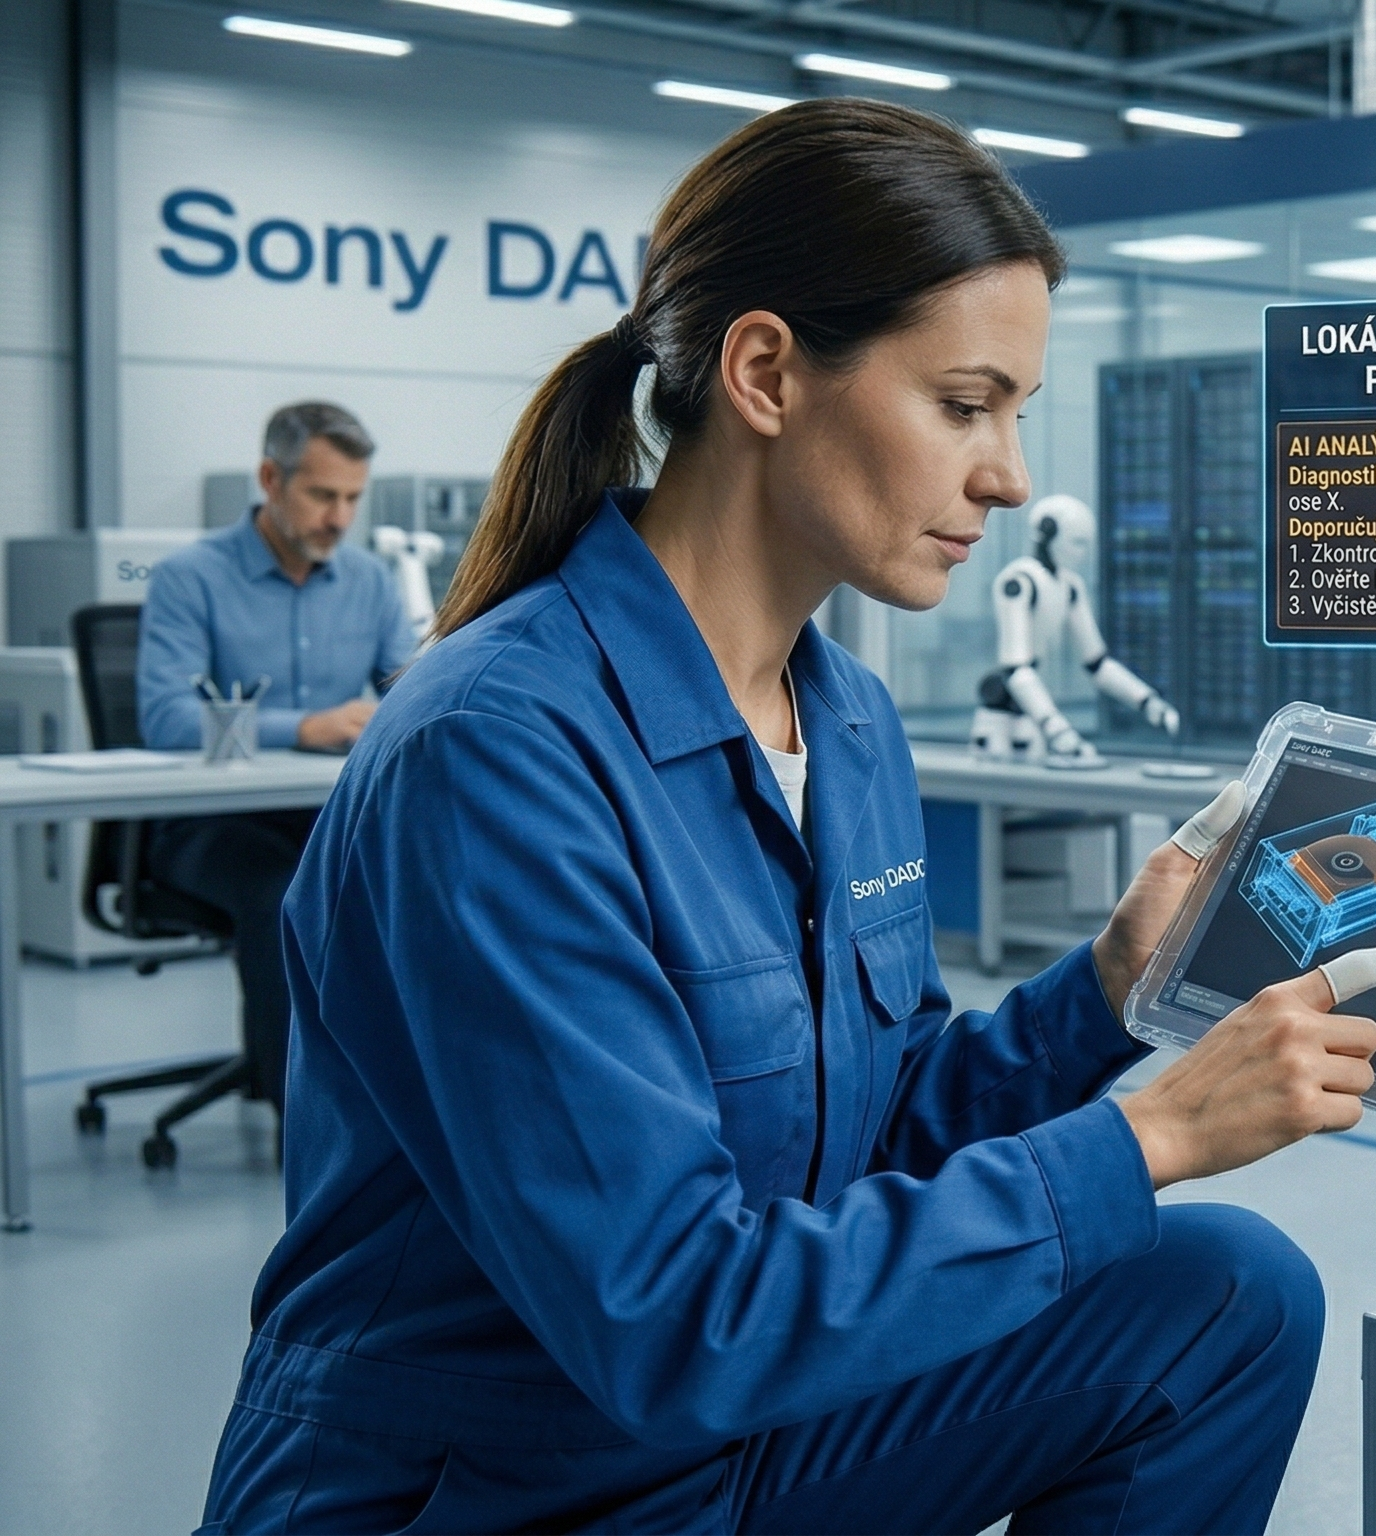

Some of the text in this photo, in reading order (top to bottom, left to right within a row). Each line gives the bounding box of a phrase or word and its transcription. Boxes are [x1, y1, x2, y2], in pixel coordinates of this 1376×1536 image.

[157, 187, 651, 312] Sony DA
[1289, 436, 1310, 457] AI
[1288, 491, 1345, 511] ose X.
[1289, 544, 1305, 563] 1.
[1288, 570, 1305, 589] 2.
[1289, 596, 1305, 615] 3.
[850, 880, 886, 900] Sony
